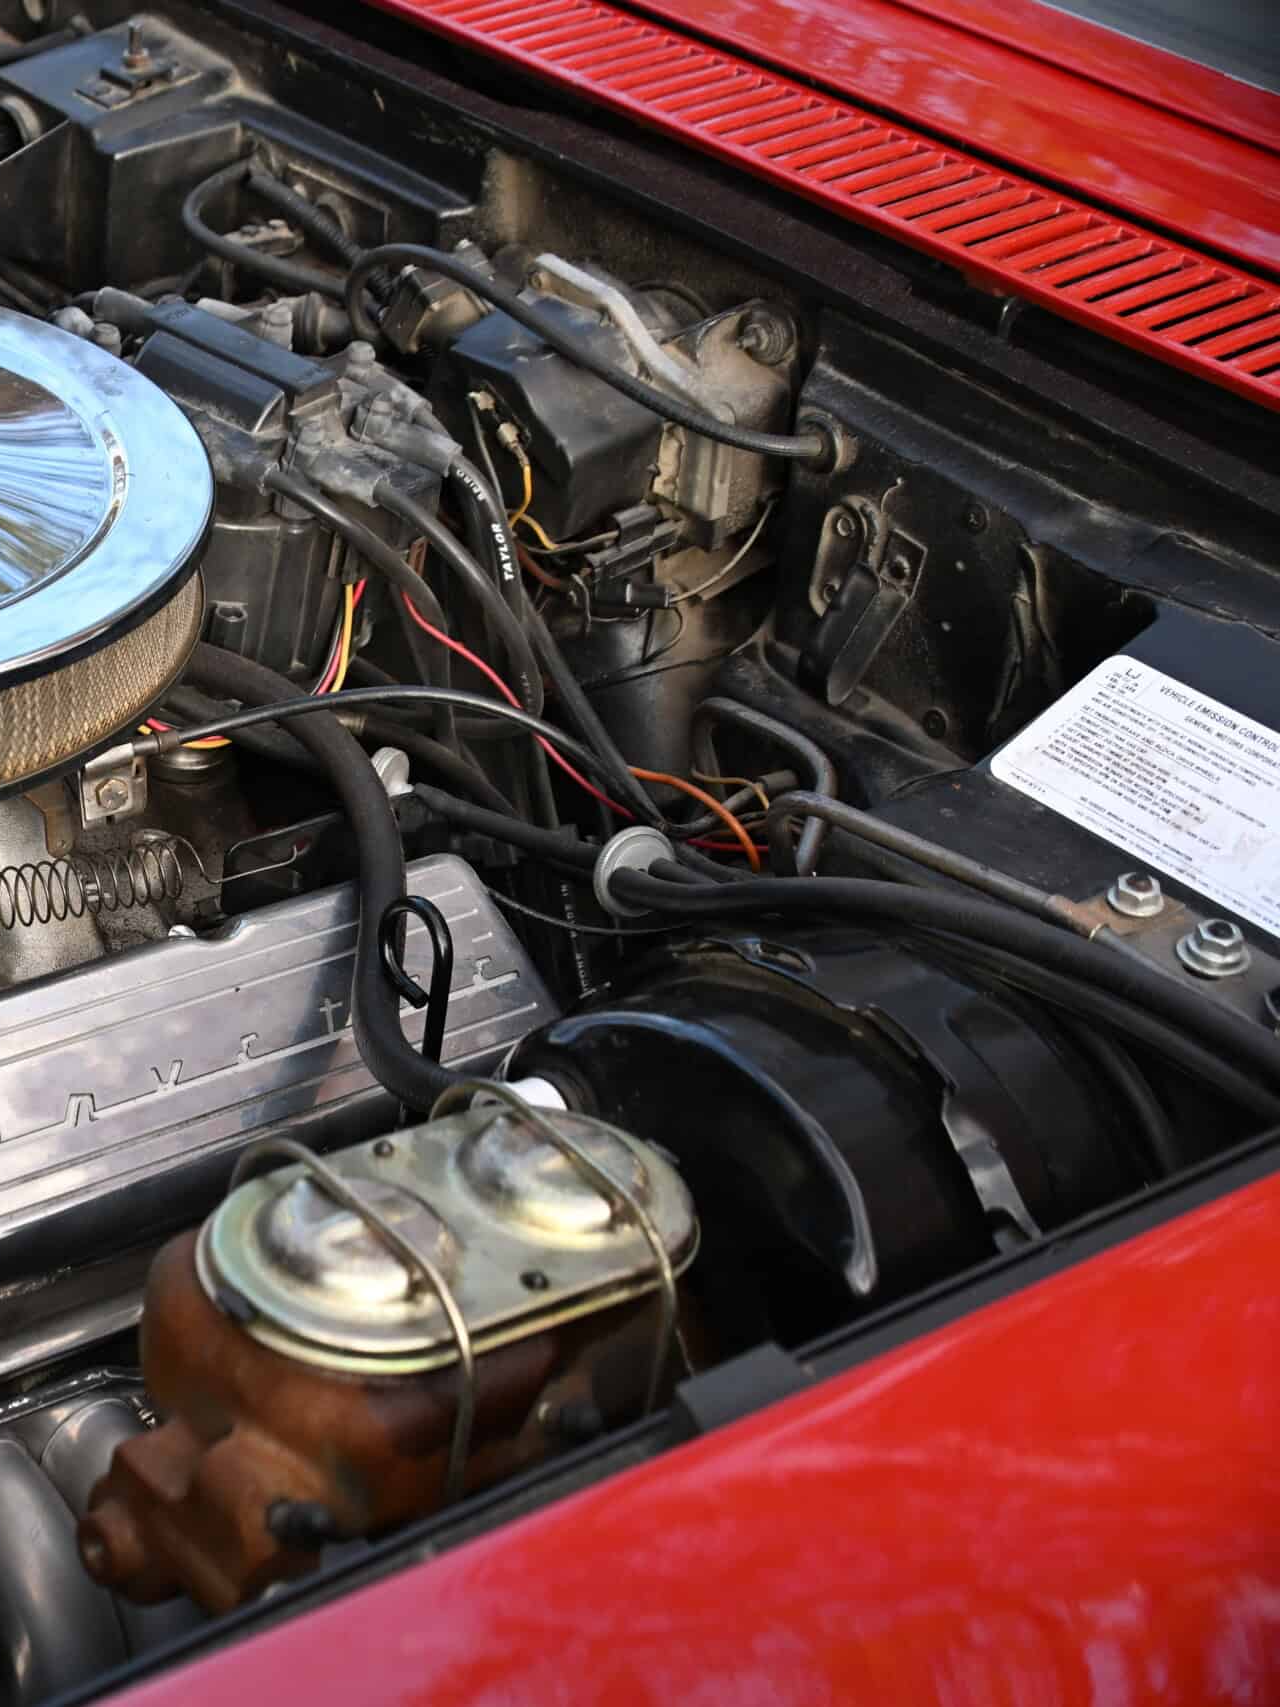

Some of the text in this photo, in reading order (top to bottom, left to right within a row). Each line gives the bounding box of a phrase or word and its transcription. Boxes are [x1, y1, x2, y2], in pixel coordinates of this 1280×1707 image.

[490, 522, 515, 581] TAYLOR
[1125, 668, 1142, 679] LJ
[1160, 686, 1279, 752] VEHICLE EMISSION CONTROL
[1184, 716, 1212, 734] GENERAL
[1215, 732, 1244, 749] MOTORS
